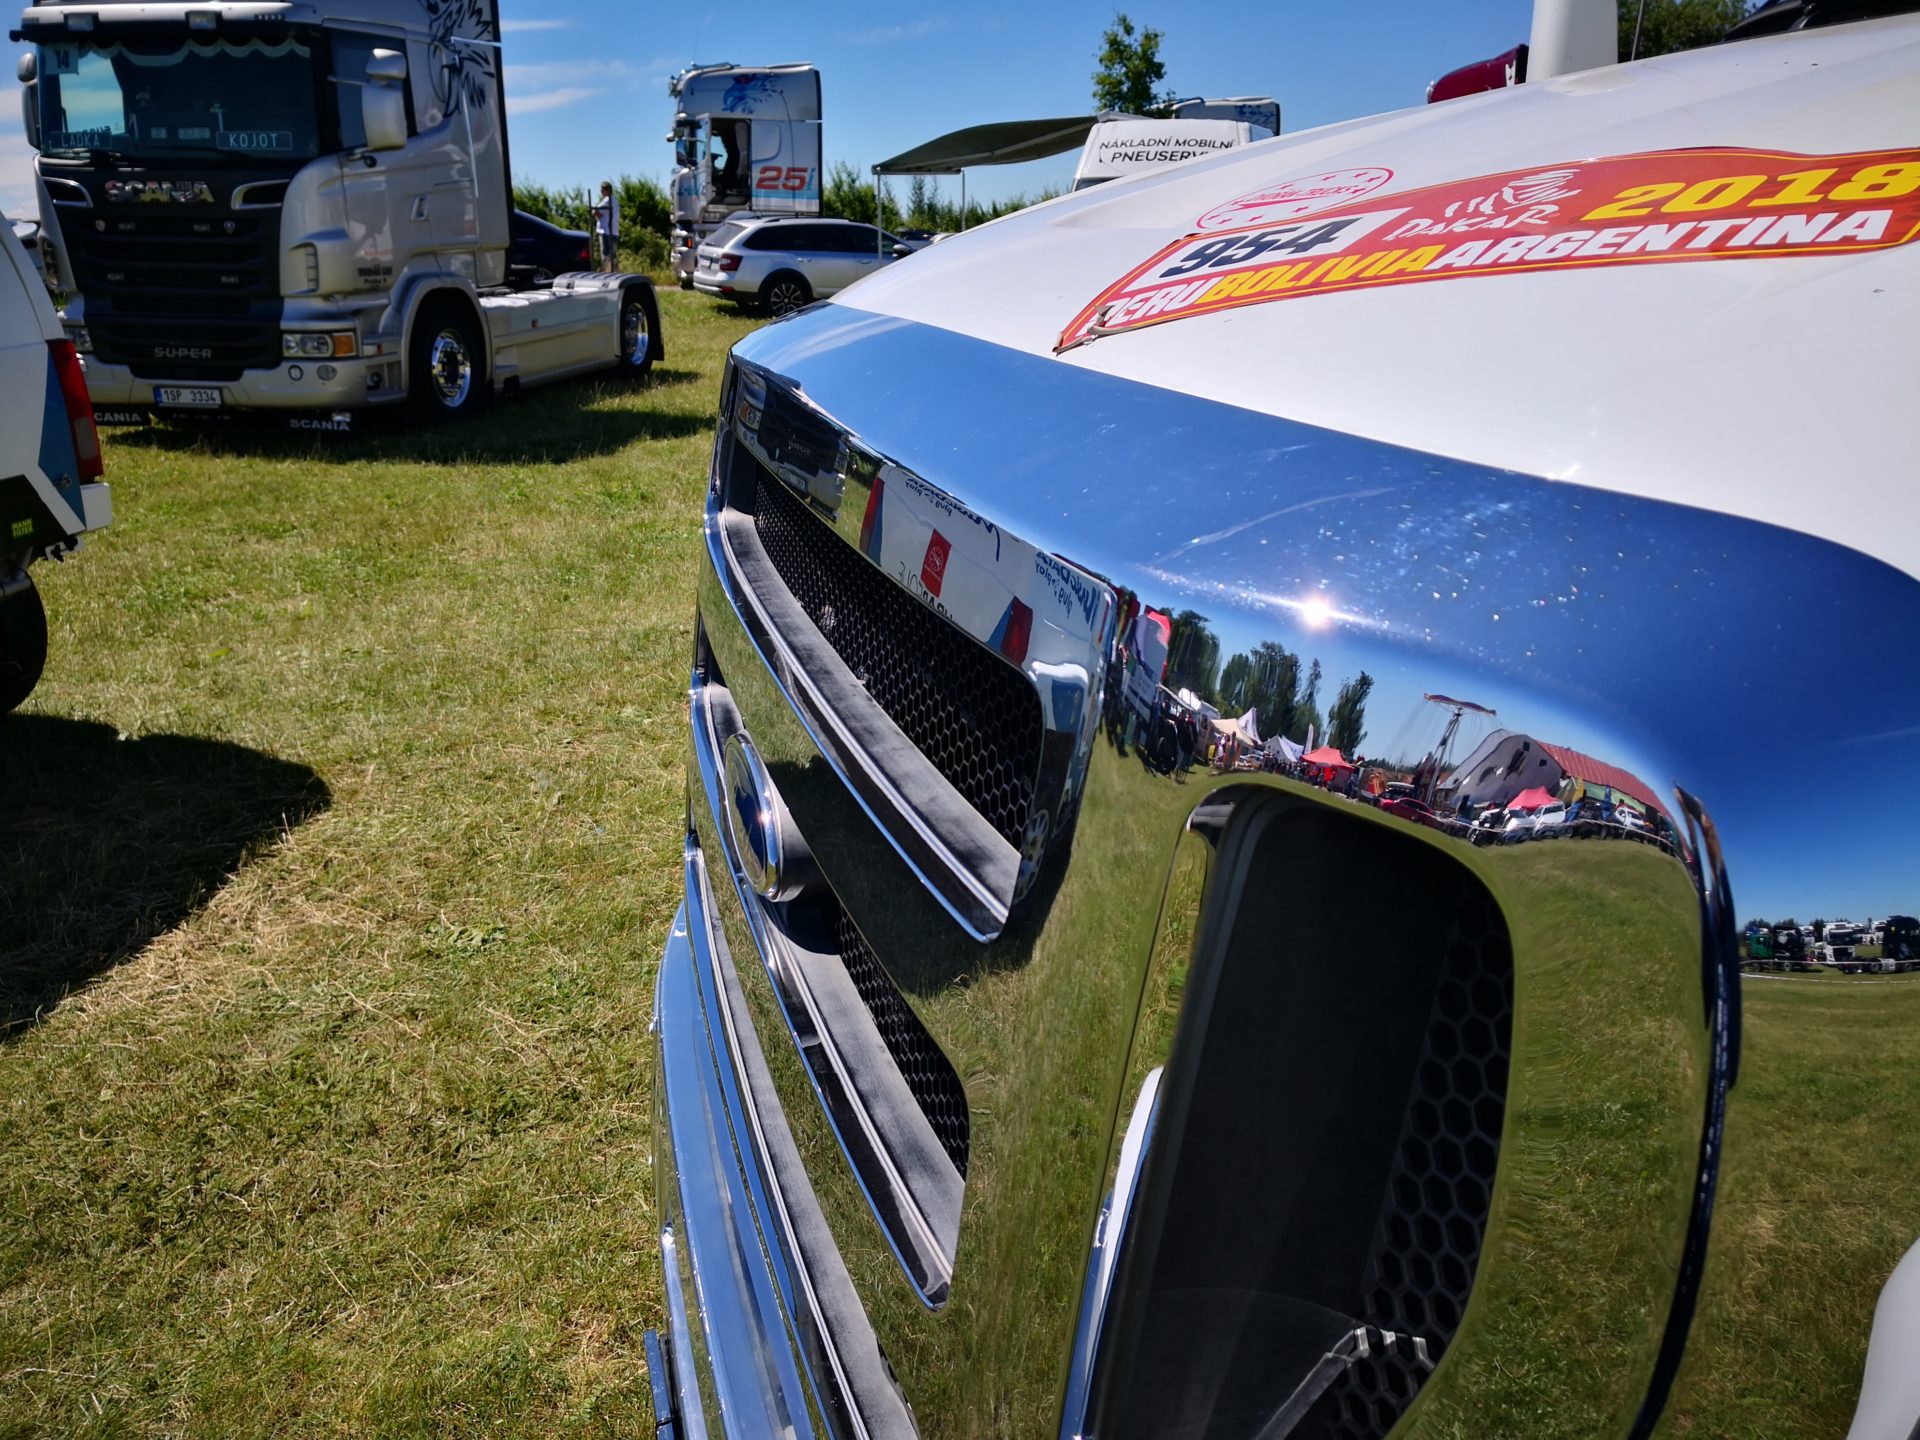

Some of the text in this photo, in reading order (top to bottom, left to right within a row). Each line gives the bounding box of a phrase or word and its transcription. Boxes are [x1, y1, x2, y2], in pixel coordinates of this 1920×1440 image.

[229, 133, 278, 148] KOJOT
[1099, 136, 1233, 149] NÁKLADNÍ MOBILNÍ
[755, 166, 808, 190] 25
[105, 181, 215, 202] SCANIA
[1580, 161, 1920, 221] 2018
[1384, 206, 1558, 240] DAKAR
[1158, 217, 1365, 278] 954
[1194, 245, 1447, 304] BOLIVIA
[1423, 210, 1894, 270] ARGENTINA
[154, 347, 212, 359] SUPER
[164, 390, 216, 402] 1SP 3334
[94, 412, 141, 423] CANIA
[290, 419, 350, 431] SCANIA
